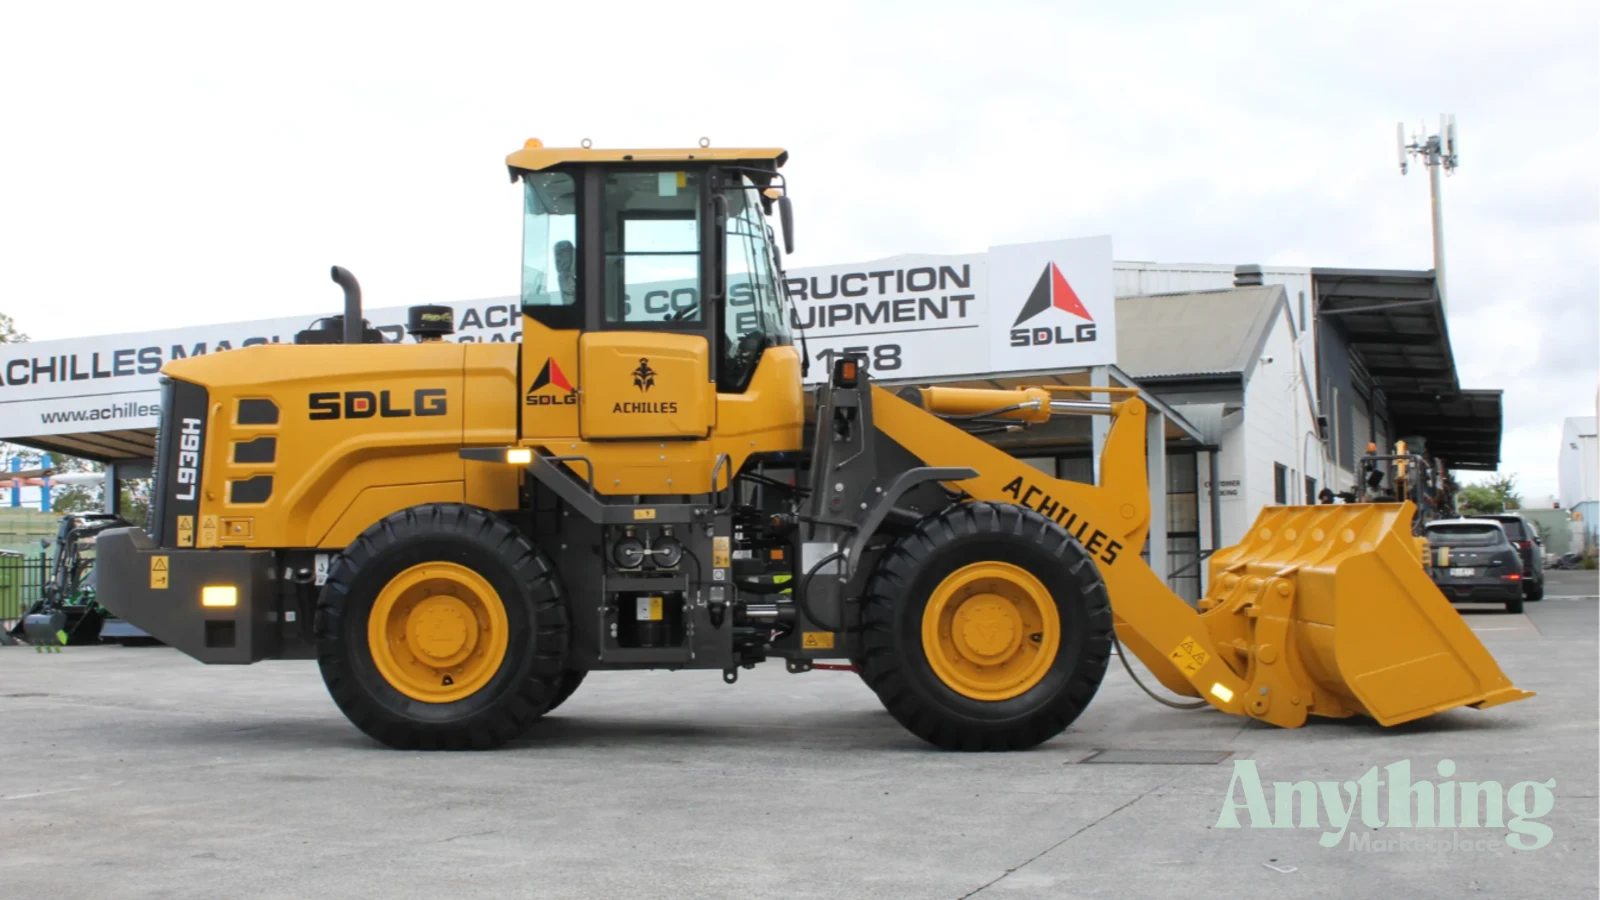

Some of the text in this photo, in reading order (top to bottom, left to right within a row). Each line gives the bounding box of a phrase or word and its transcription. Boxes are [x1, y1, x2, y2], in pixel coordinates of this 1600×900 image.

[736, 294, 975, 334] EUIPMENT
[1010, 323, 1096, 347] SDLG
[308, 388, 447, 421] SDLG
[526, 394, 577, 406] SDLG
[612, 402, 678, 414] ACHILLES
[176, 418, 201, 500] L936H
[1001, 475, 1123, 566] ACHILLES
